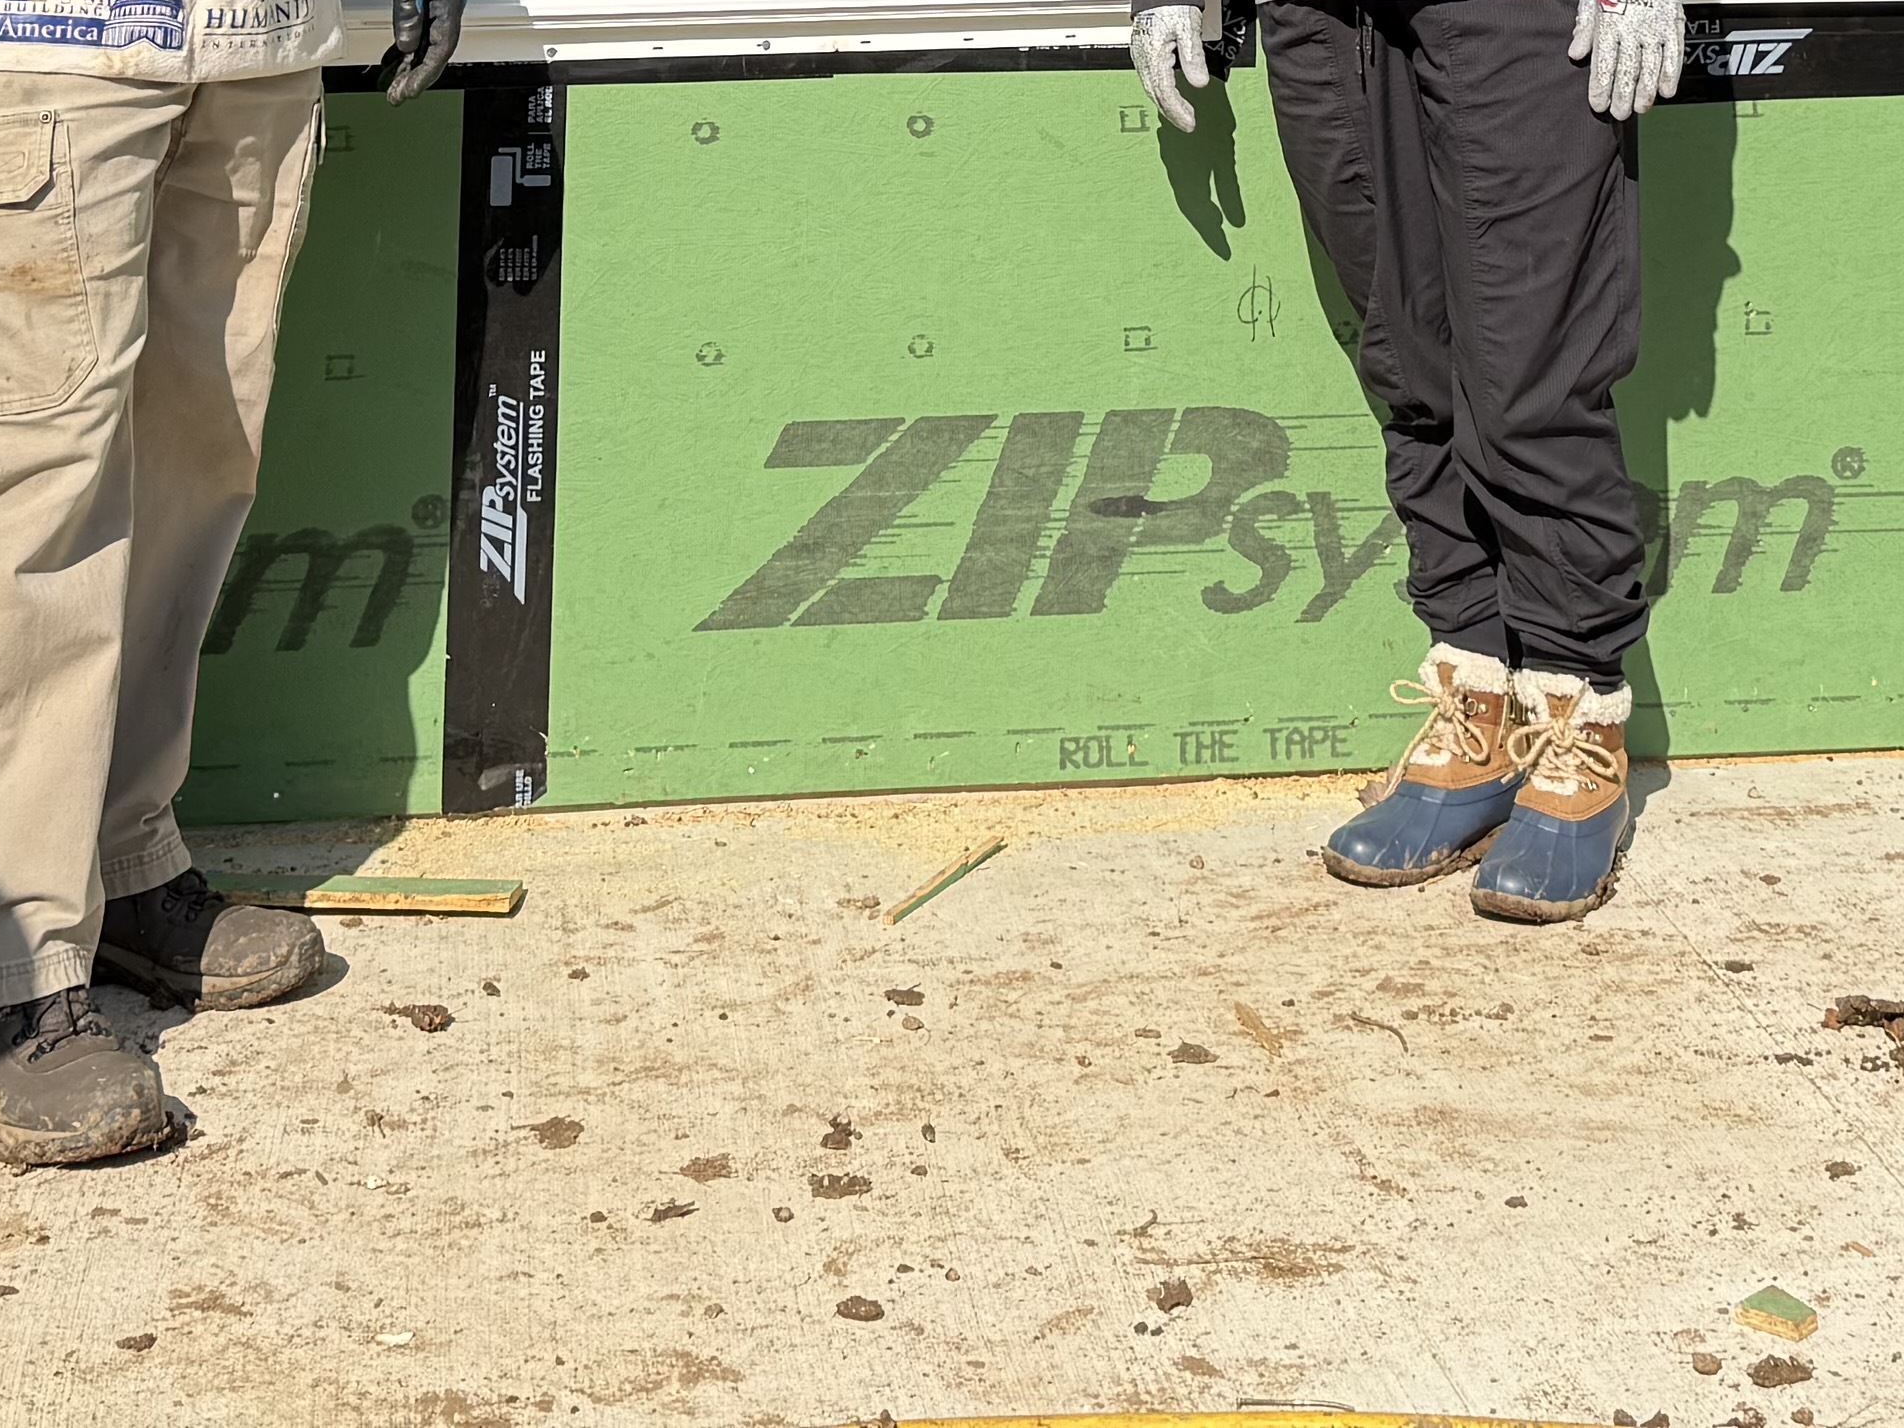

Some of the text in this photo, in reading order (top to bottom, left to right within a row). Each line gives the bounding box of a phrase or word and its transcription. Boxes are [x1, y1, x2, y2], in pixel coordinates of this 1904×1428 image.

[0, 20, 100, 45] America
[527, 140, 536, 172] ROLL
[527, 349, 547, 504] FLASHING TAPE
[1058, 723, 1351, 773] ROLL THE TAPE
